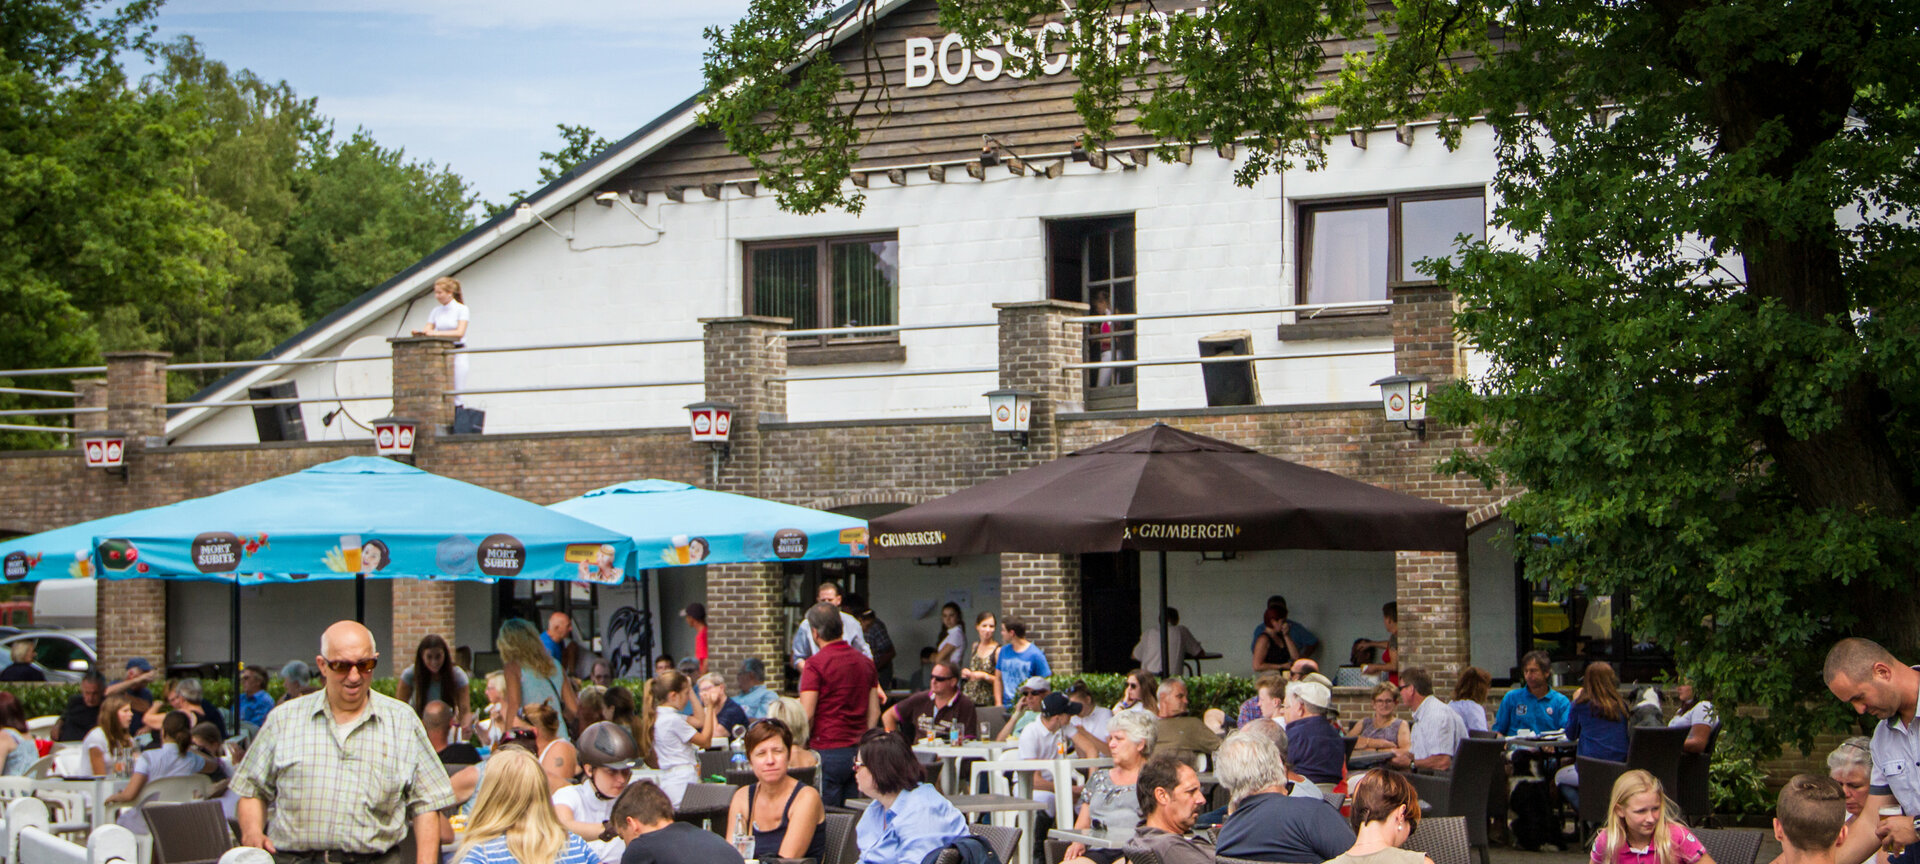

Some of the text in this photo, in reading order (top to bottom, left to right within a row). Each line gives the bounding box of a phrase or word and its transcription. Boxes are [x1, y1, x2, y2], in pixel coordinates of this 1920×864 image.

[1139, 523, 1235, 539] GRIMBERGEN
[880, 530, 942, 547] GRIMBERGEN
[200, 543, 231, 555] MORT
[487, 548, 517, 559] MORT
[198, 552, 235, 565] SUBITE
[484, 557, 519, 569] SUBITE
